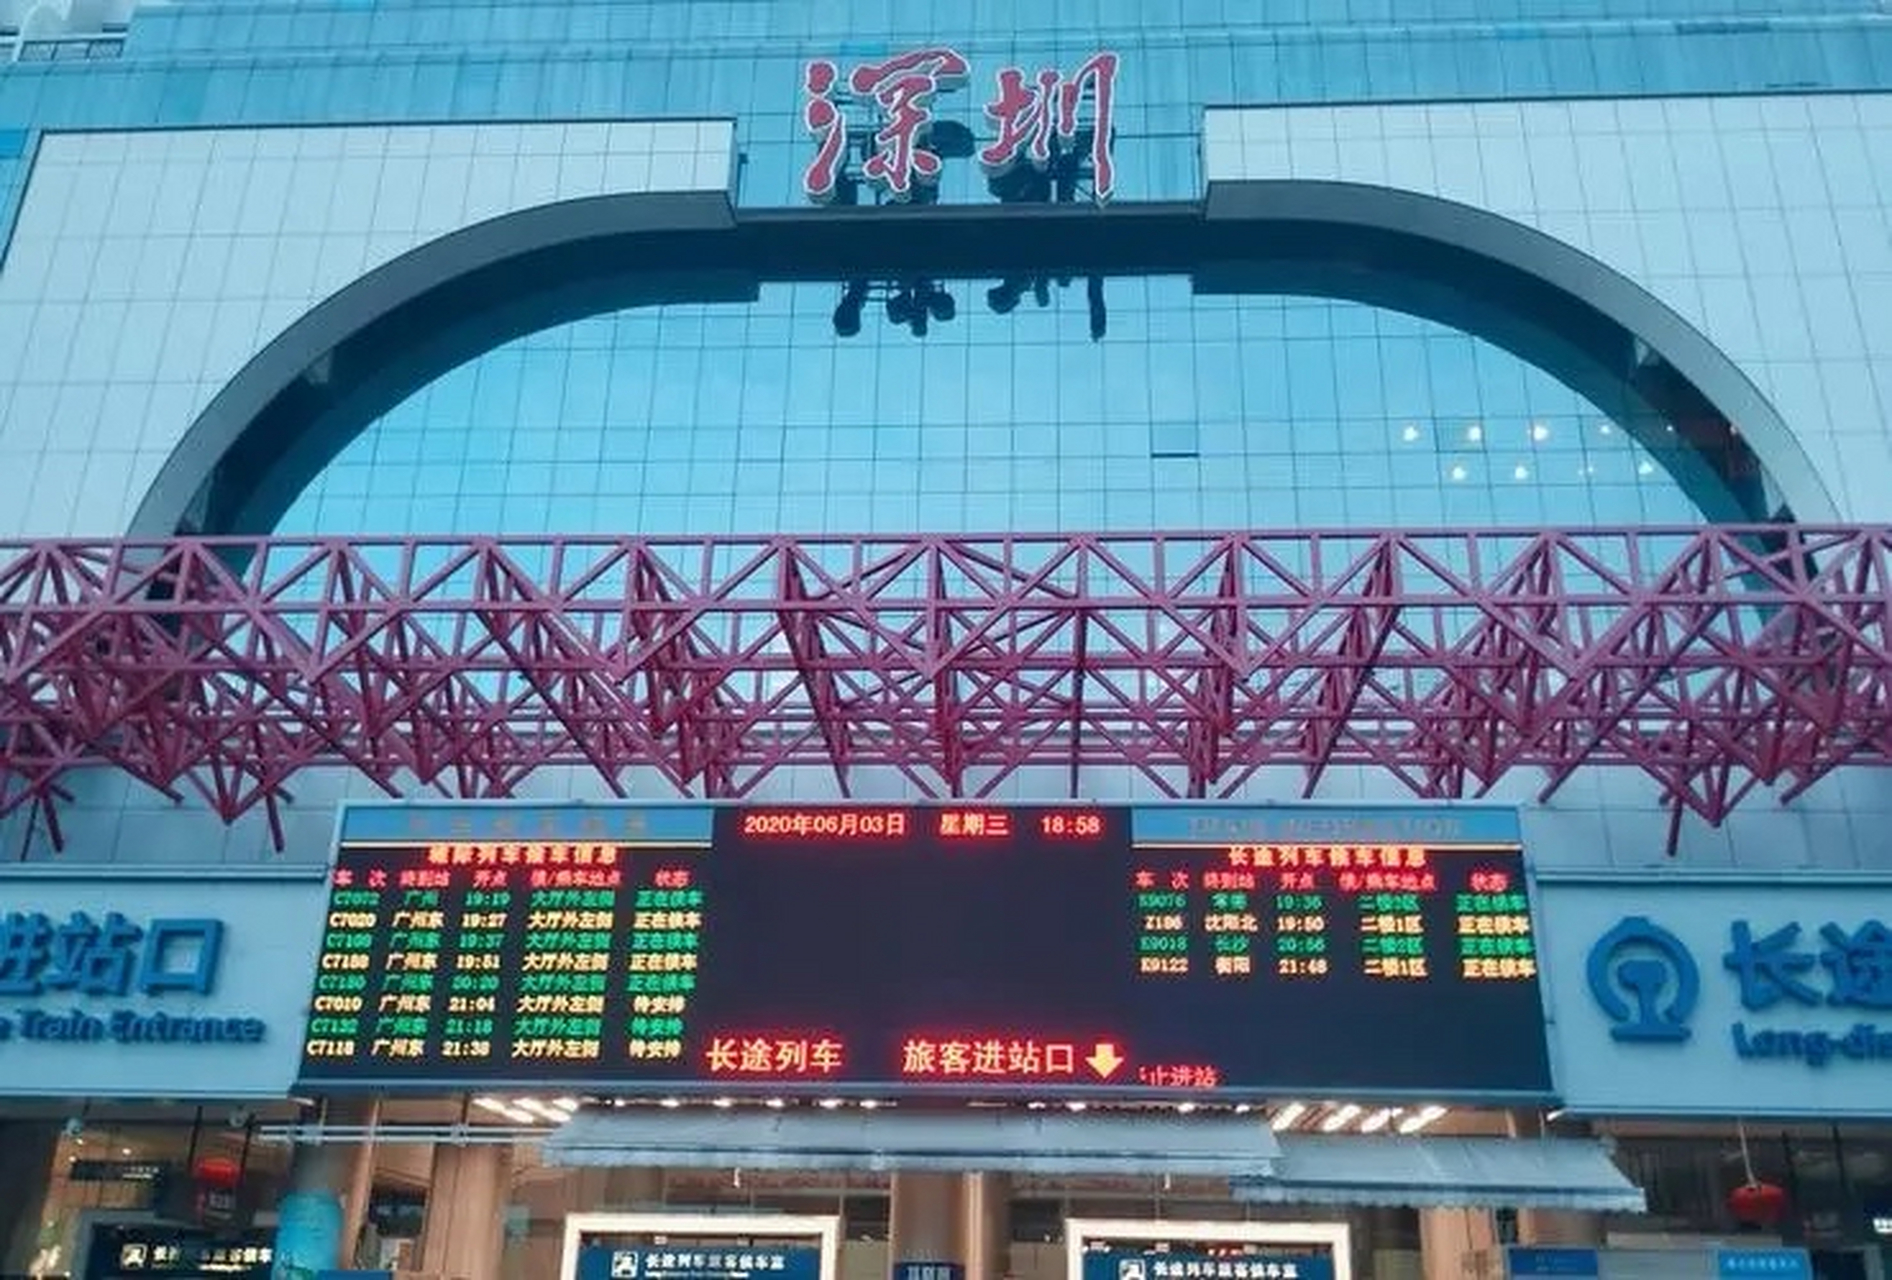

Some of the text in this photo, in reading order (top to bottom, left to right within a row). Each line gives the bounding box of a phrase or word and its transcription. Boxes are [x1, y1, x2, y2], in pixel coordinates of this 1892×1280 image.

[804, 48, 1118, 200] 深圳
[745, 813, 1101, 836] 2020年06月03日 星期三 18:58
[403, 890, 439, 907] 广州
[392, 912, 444, 929] 广州东
[632, 912, 702, 929] 正在候车
[1458, 915, 1529, 933] 正在候车
[389, 933, 441, 949] 广州东
[631, 933, 700, 949] 正在候车
[385, 954, 438, 971] 广州东
[629, 954, 698, 971] 正在候车
[1463, 958, 1537, 977] 正在候车
[1723, 919, 1892, 1011] 长途
[382, 975, 435, 992] 广州东
[628, 975, 696, 992] 正在候车
[378, 996, 432, 1013] 广州东
[19, 1008, 104, 1041] Train
[111, 1009, 267, 1044] Entrance
[375, 1017, 428, 1035] 广州东
[371, 1039, 425, 1057] 广州东
[706, 1037, 1075, 1075] 长途列车 旅客进站口
[1139, 1064, 1215, 1086] 止进站
